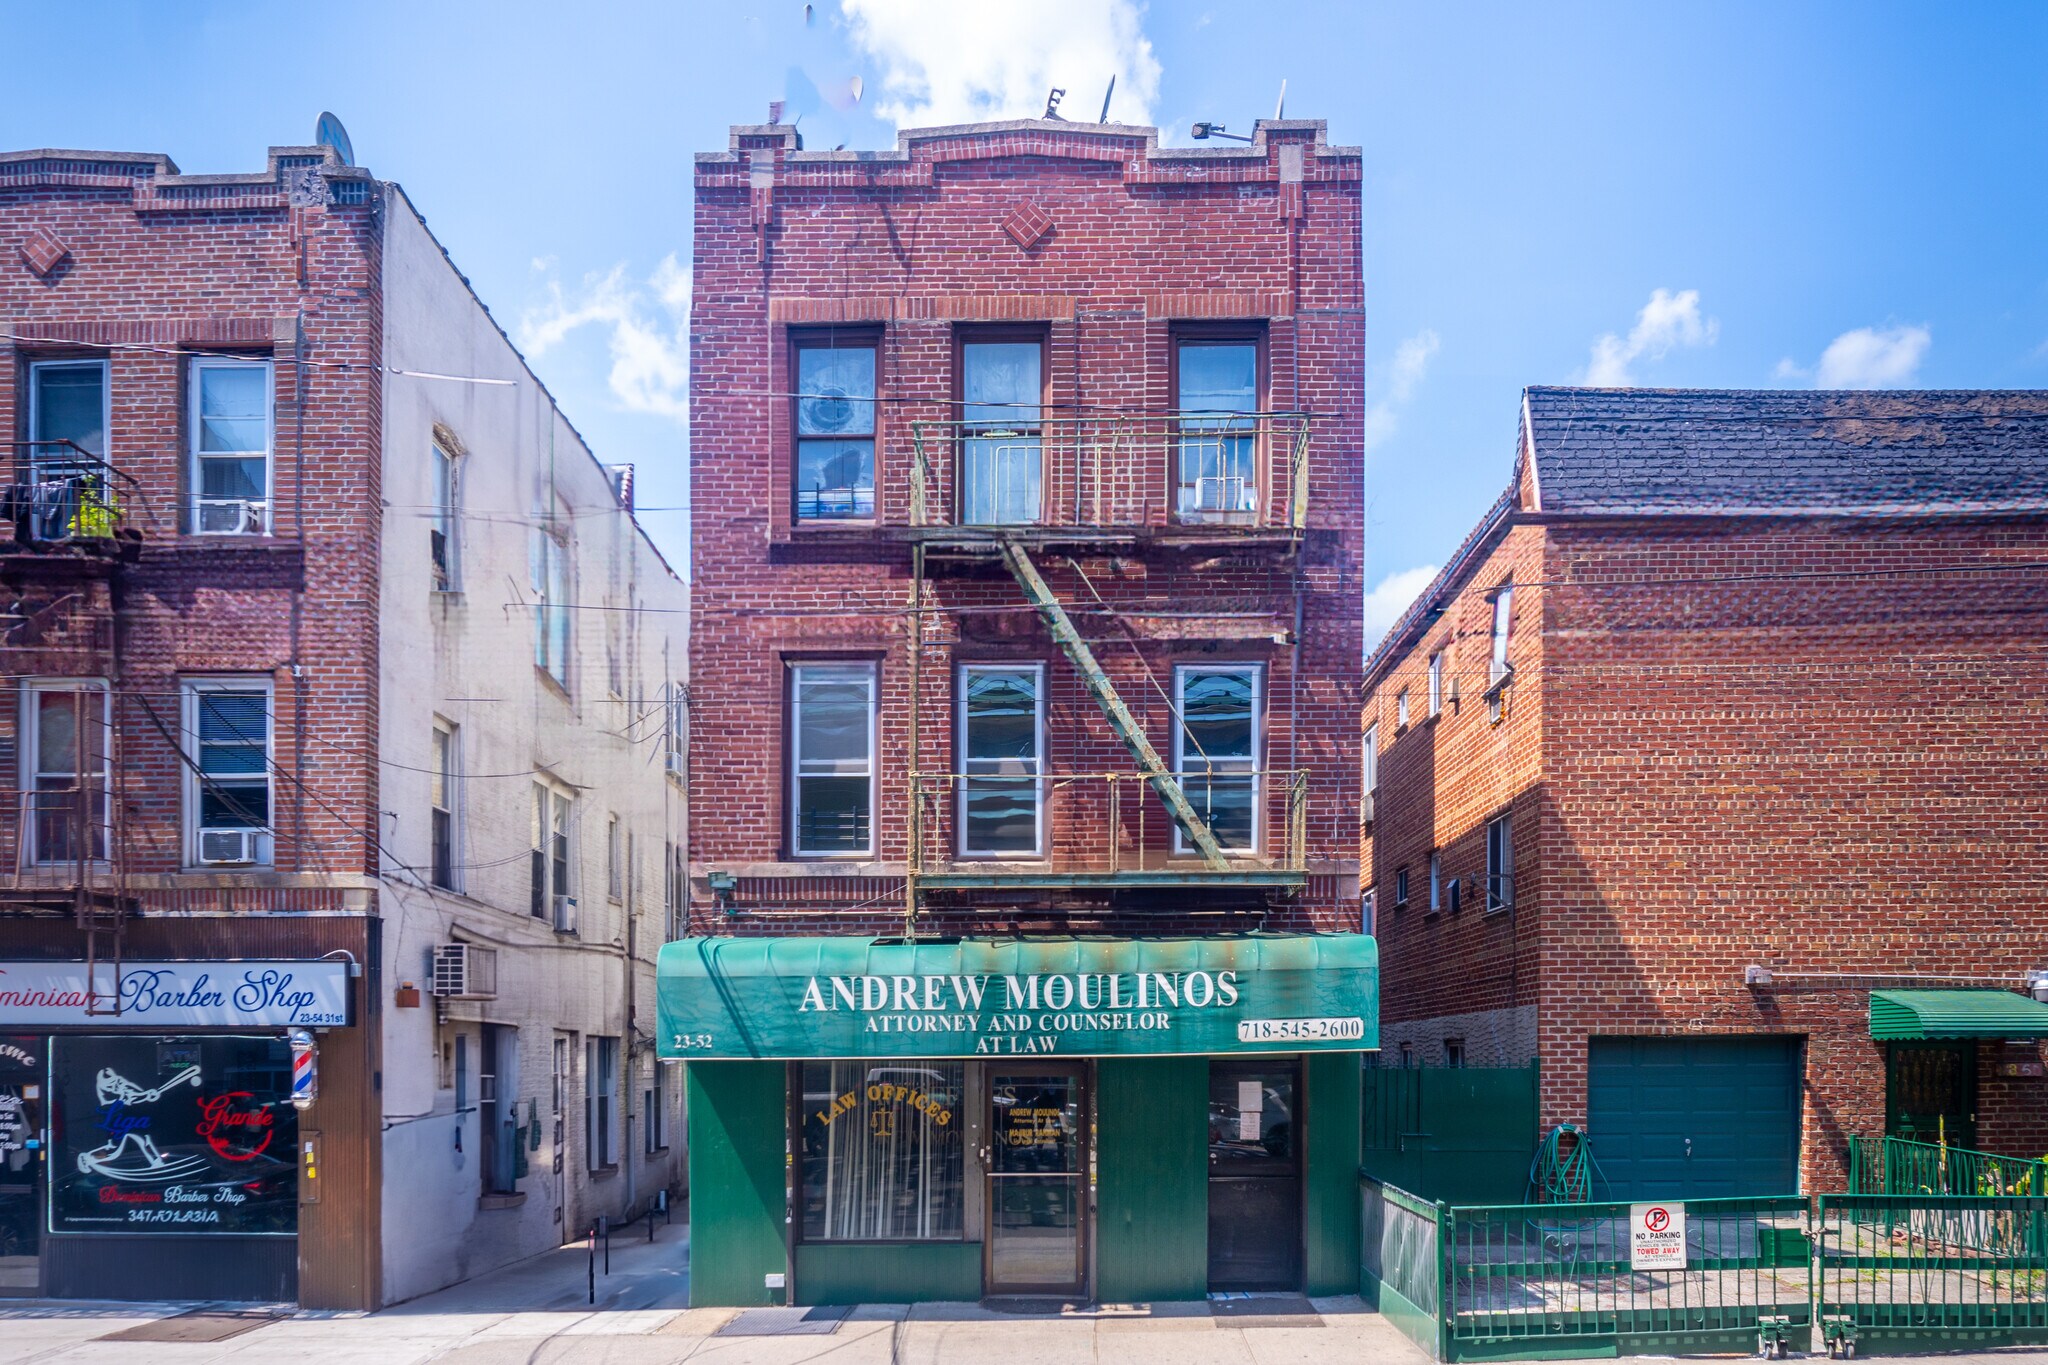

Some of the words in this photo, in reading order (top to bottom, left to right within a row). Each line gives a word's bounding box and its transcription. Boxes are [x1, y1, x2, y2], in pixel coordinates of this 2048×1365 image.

[114, 970, 226, 1013] Barber
[233, 970, 316, 1022] Shop
[798, 975, 990, 1012] ANDREW
[1002, 970, 1239, 1010] MOULINOS
[300, 1013, 323, 1023] 23-54
[325, 1013, 344, 1023] 31st
[865, 1014, 982, 1032] ATTORNEY
[988, 1013, 1032, 1031] AND
[1039, 1012, 1170, 1031] COUNSELOR
[1241, 1020, 1360, 1039] 718-545-2600
[673, 1035, 713, 1049] 23-52
[975, 1036, 1005, 1053] AT
[1010, 1035, 1058, 1053] LAW
[816, 1091, 857, 1126] LAW
[867, 1085, 952, 1126] OFFICES
[93, 1099, 151, 1140] Liga
[196, 1093, 274, 1135] Grande
[164, 1185, 210, 1204] Barber
[213, 1186, 247, 1206] Shop
